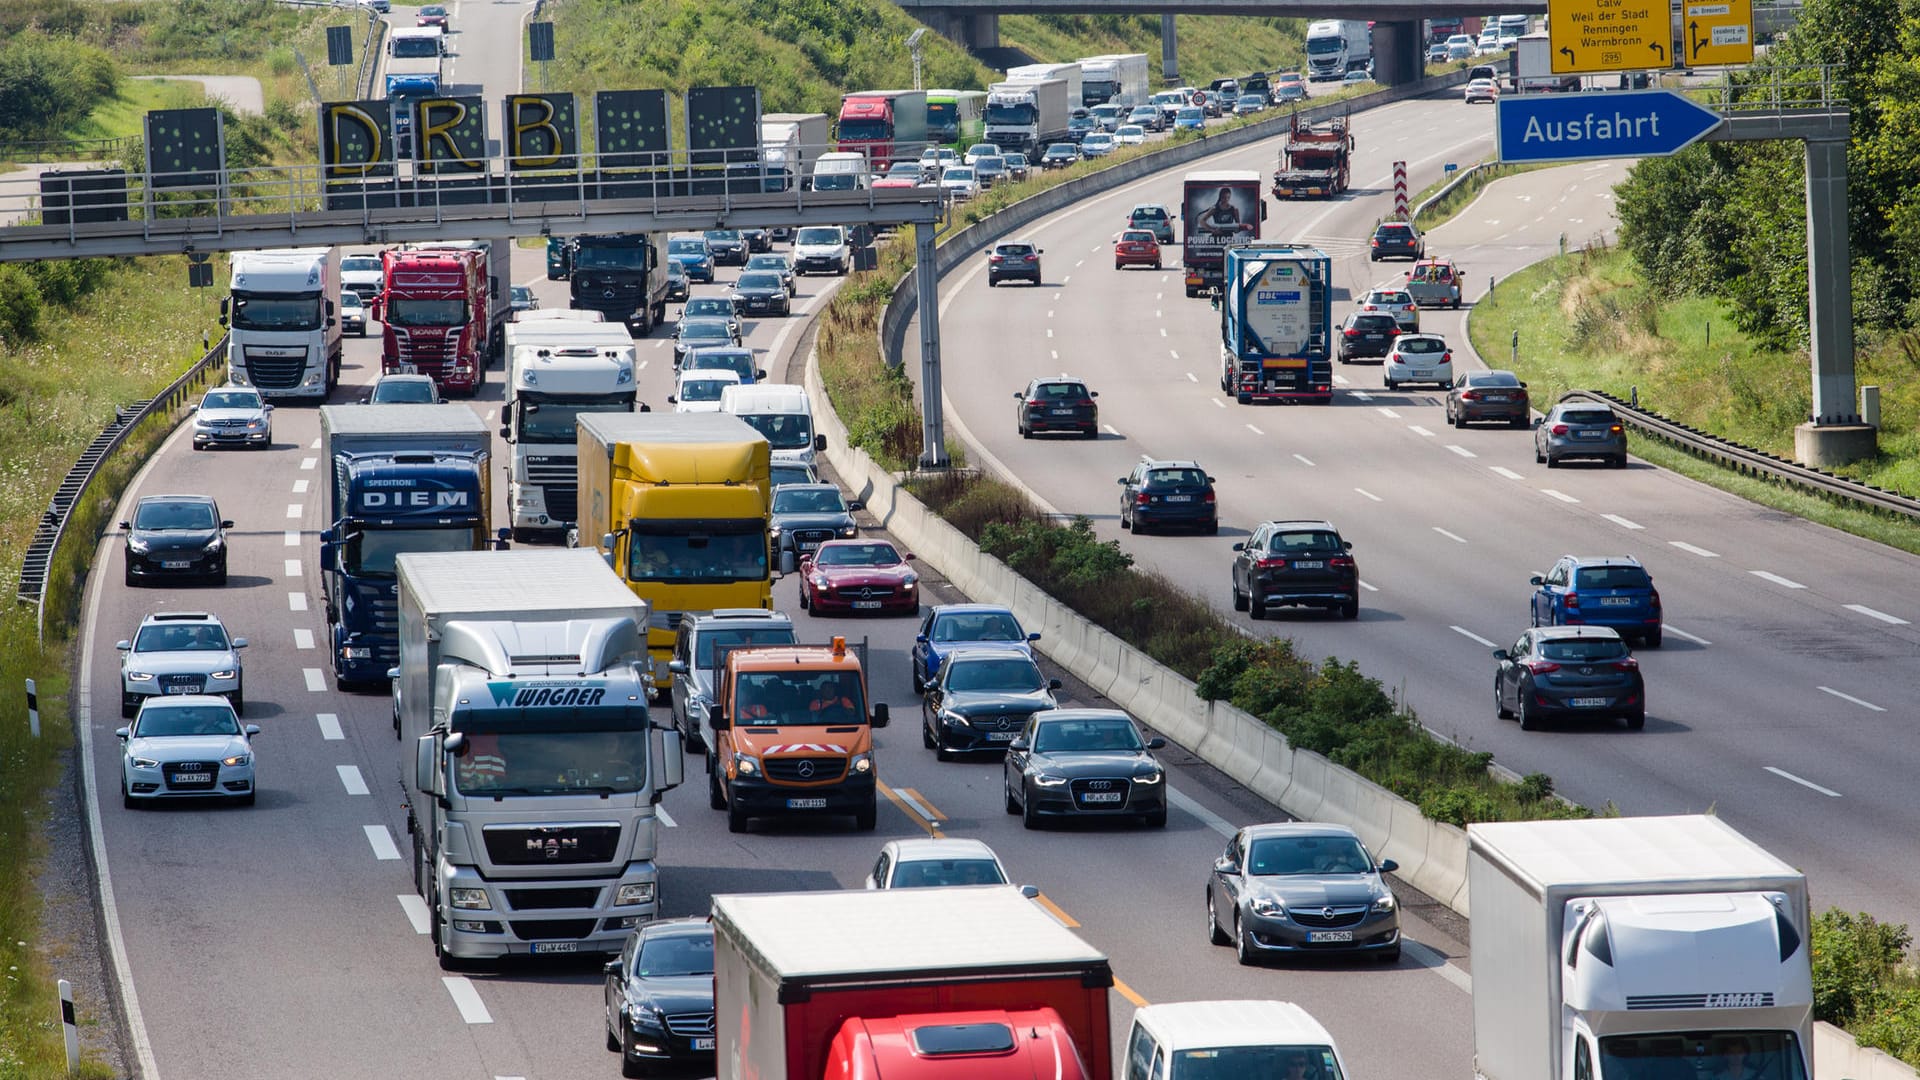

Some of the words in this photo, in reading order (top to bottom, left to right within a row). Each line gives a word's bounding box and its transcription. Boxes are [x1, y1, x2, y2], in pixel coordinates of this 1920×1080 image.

[1571, 12, 1594, 21] Weil
[1598, 12, 1616, 20] der
[1621, 10, 1649, 19] Stadt
[1583, 24, 1638, 35] Renningen
[1581, 37, 1642, 47] Warmbronn
[1604, 53, 1620, 62] 295
[1523, 112, 1660, 143] Ausfahrt
[1187, 235, 1215, 244] POWER
[368, 479, 412, 487] SPEDITION
[363, 491, 468, 506] DIEM
[515, 687, 606, 707] WAGNER
[527, 838, 578, 849] MAN
[1705, 993, 1764, 1008] LAMAR
